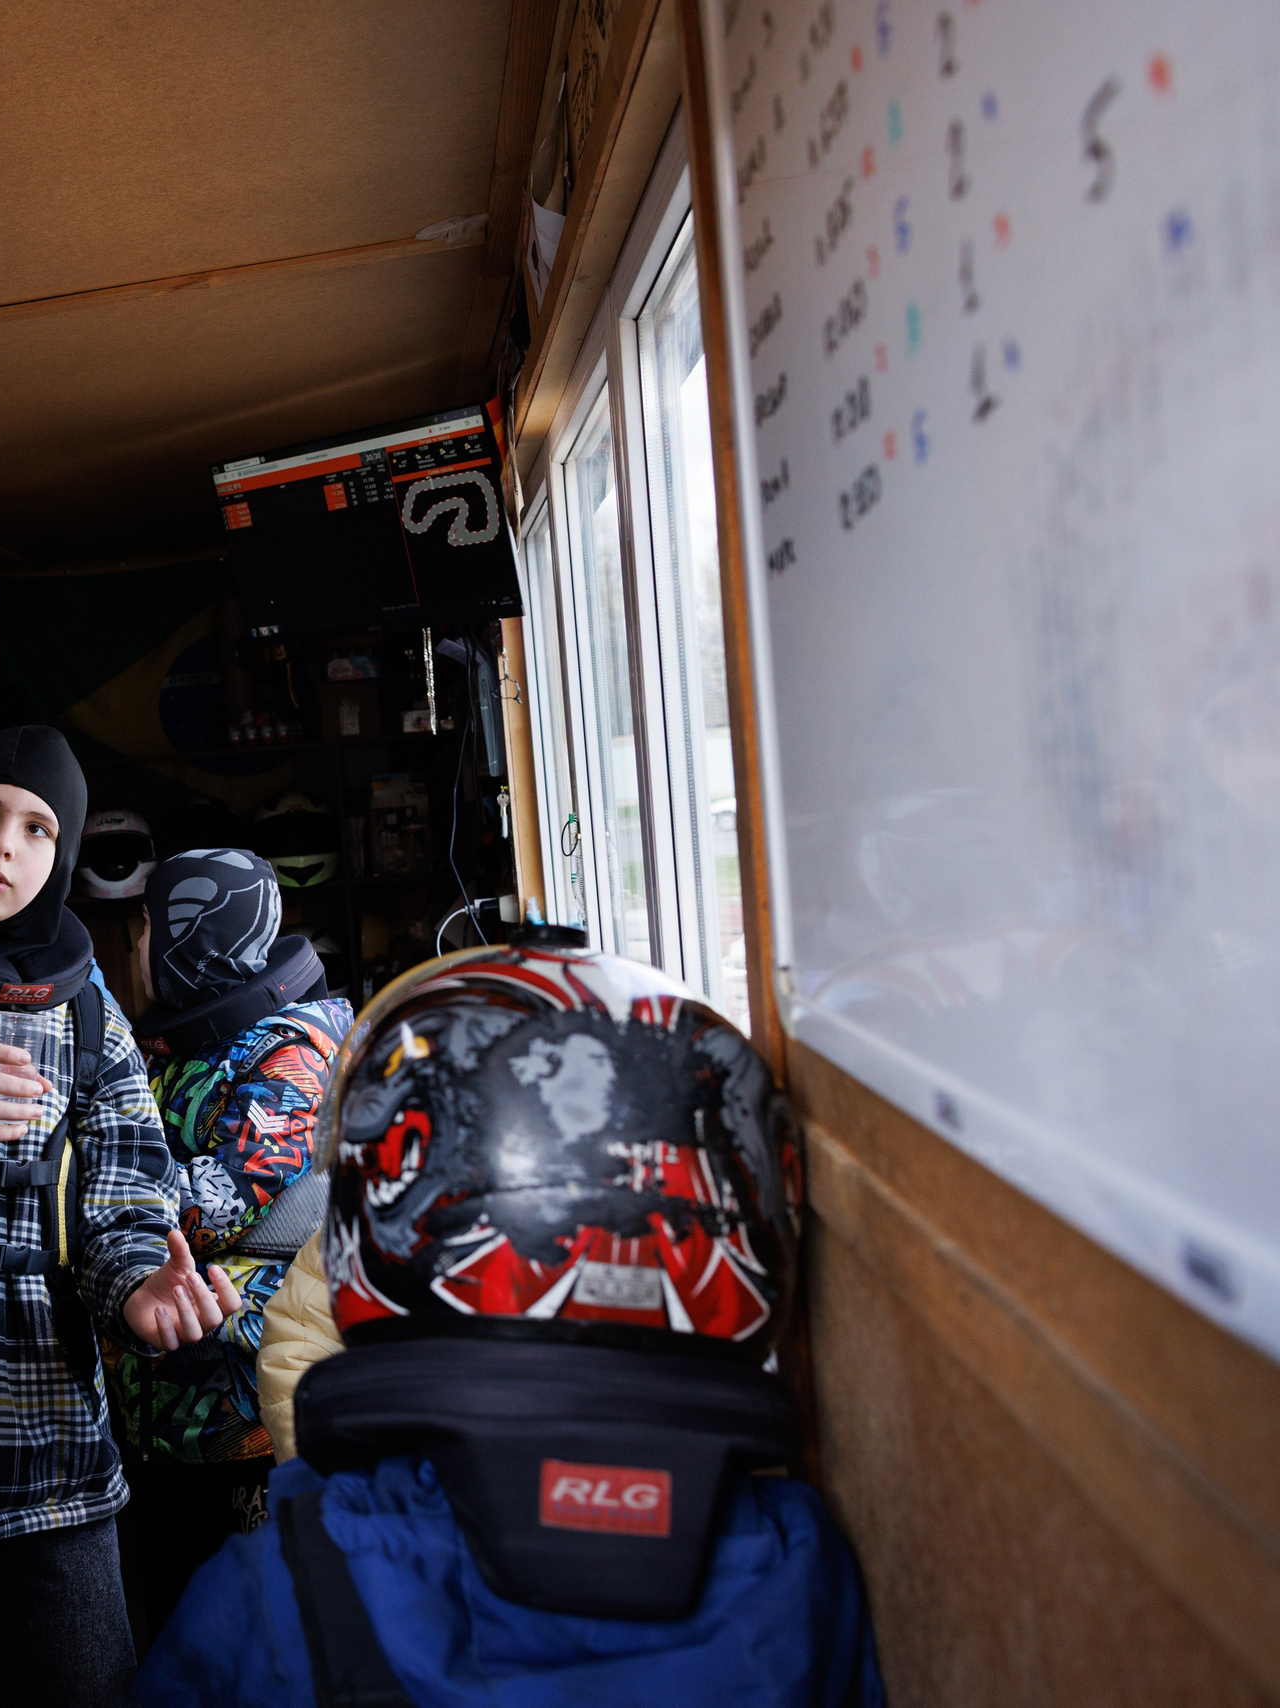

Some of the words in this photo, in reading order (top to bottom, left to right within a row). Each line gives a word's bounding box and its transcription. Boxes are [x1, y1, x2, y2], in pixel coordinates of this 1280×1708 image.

[3, 987, 50, 998] RLG
[140, 1039, 164, 1050] RLG
[549, 1475, 661, 1511] RLG
